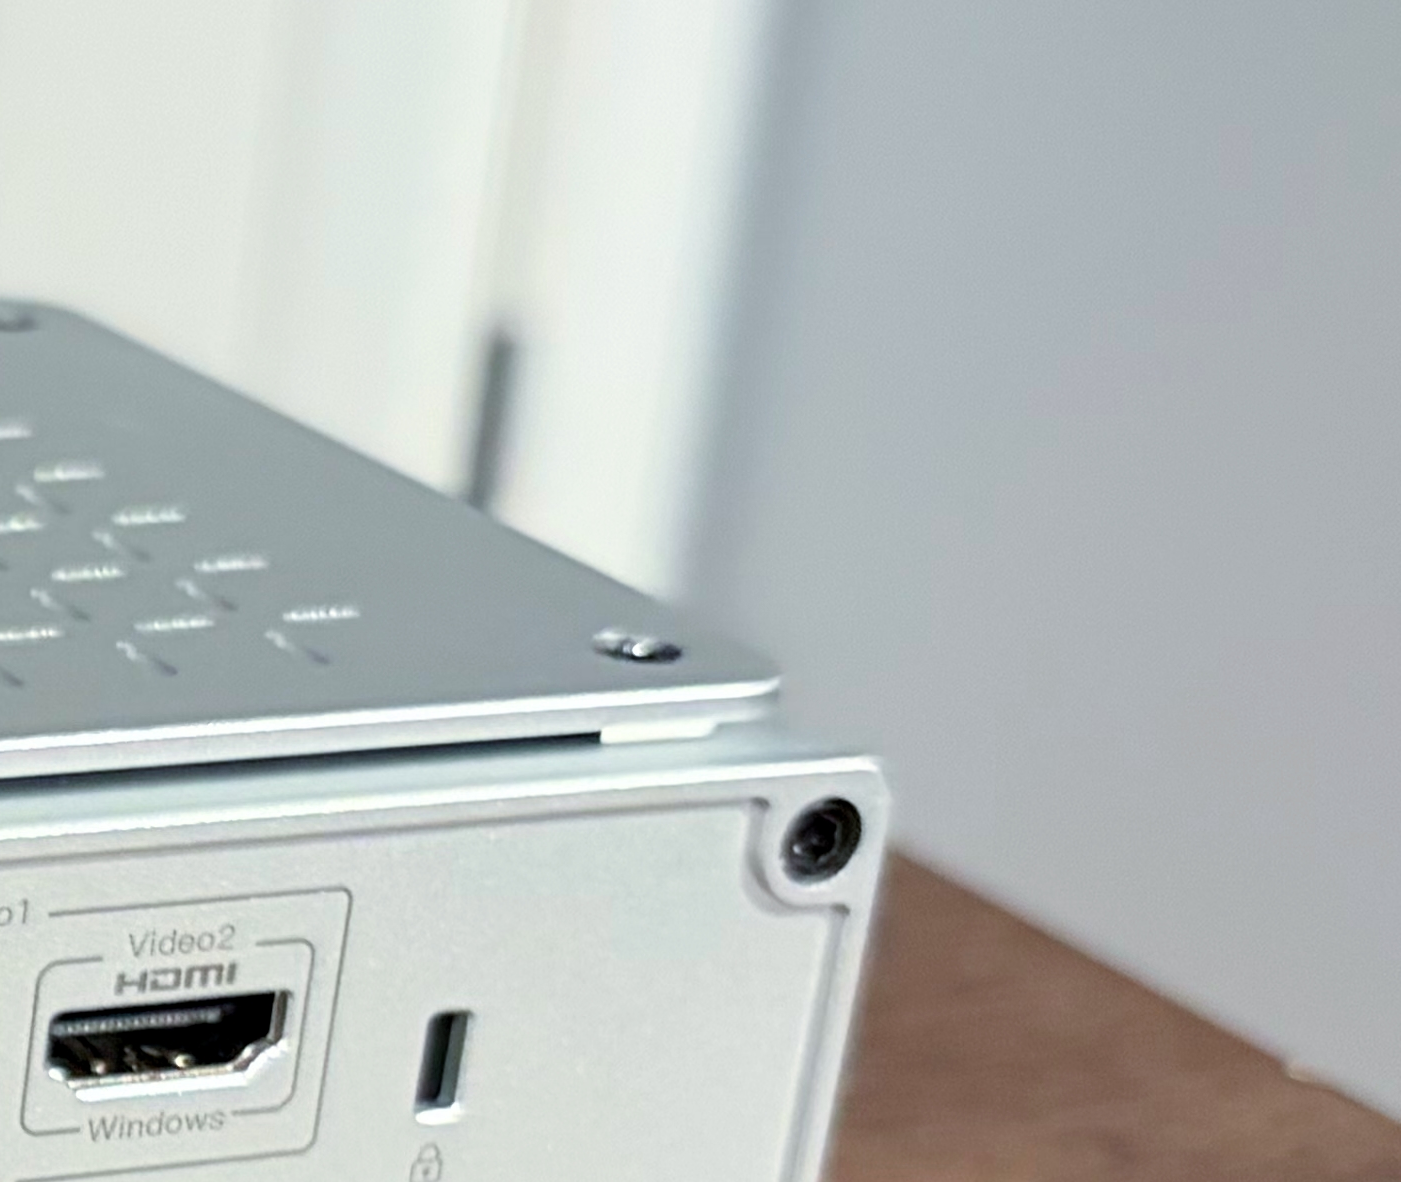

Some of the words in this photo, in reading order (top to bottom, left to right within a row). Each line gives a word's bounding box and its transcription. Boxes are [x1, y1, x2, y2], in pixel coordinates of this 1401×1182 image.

[128, 926, 236, 956] Video2
[115, 963, 237, 994] HDMI
[88, 1109, 225, 1141] Windows
